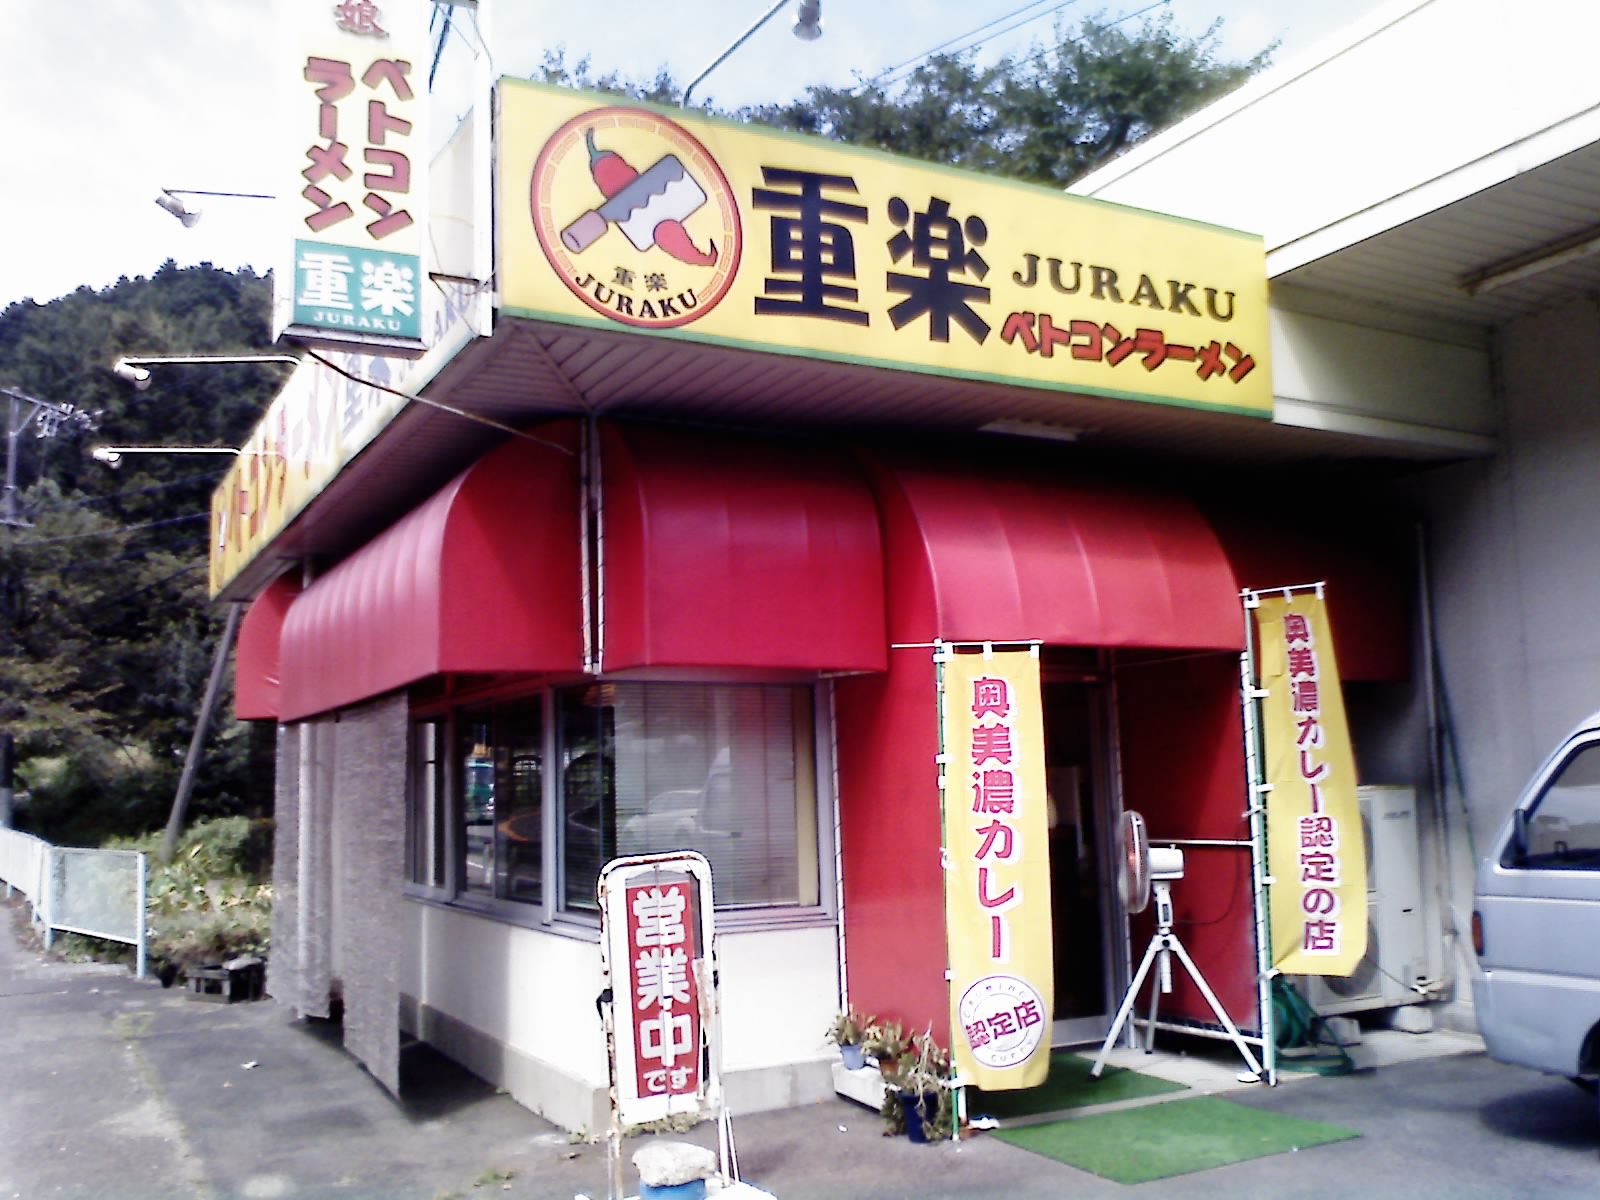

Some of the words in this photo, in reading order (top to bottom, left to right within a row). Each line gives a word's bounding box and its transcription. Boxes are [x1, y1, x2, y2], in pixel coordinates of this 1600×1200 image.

[301, 56, 355, 233] ラーメン
[361, 59, 414, 240] ベトコン
[298, 252, 415, 317] 重楽
[575, 272, 699, 319] JURAKU
[752, 166, 992, 346] 重楽
[1012, 252, 1236, 323] JURAKU
[313, 310, 401, 331] JURAKU
[1001, 310, 1256, 384] ベトコンラーメン
[971, 675, 1015, 959] 奥美濃カレー
[1283, 613, 1338, 951] 奥美濃カレー認定の店
[632, 886, 694, 1093] 営業中です
[965, 999, 1041, 1051] 認定店
